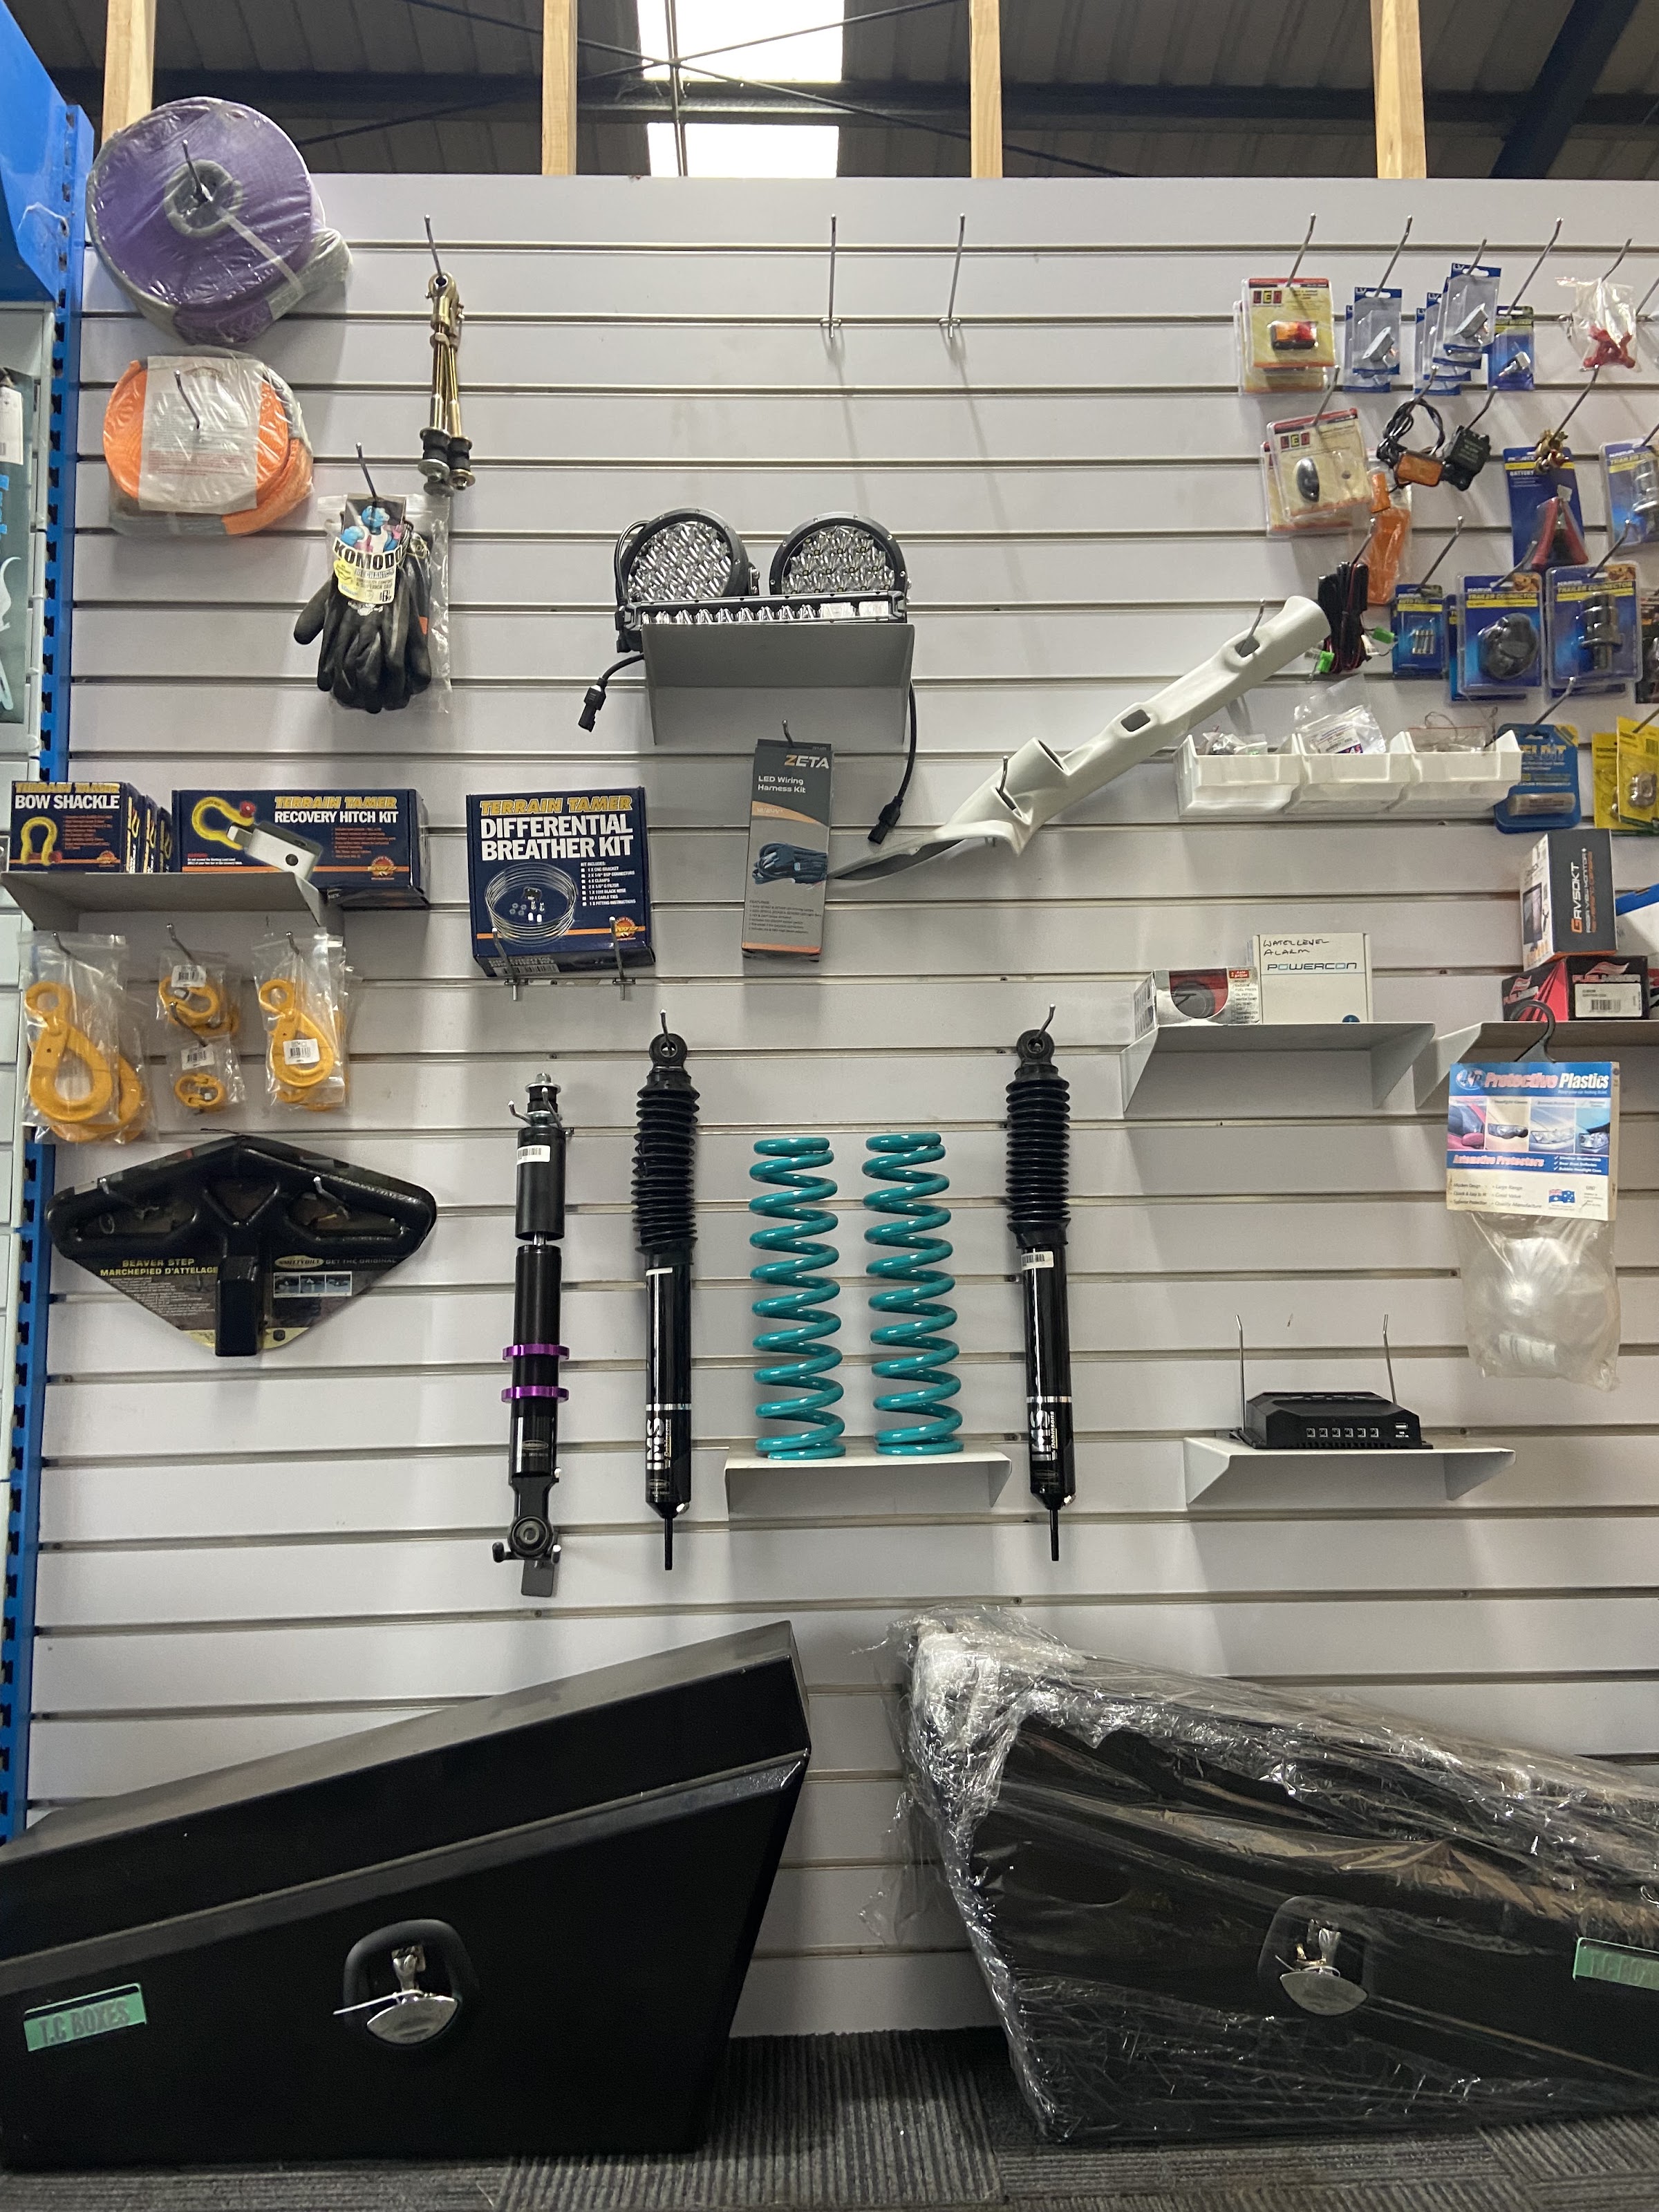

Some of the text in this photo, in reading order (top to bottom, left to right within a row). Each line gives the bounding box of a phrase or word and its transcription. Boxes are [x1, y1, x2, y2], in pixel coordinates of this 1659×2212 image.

[334, 540, 403, 570] KOMODO
[784, 754, 830, 769] ZETA
[778, 776, 804, 785] Wiring
[758, 785, 792, 793] Harness
[15, 795, 120, 809] BOW SHACKLE
[274, 796, 397, 809] TERRAIN TAMER
[480, 795, 632, 816] TERRAIN TAMER
[274, 810, 399, 823] RECOVERY HITCH KIT
[480, 813, 633, 838] DIFFERENTIAL
[482, 834, 634, 861] BREATHER KIT
[1267, 962, 1357, 971] POWERCON
[1485, 1072, 1609, 1089] Protective Plastics
[1453, 1154, 1544, 1167] Automotive Protectors
[122, 1258, 195, 1268] BEAVER STEP
[100, 1266, 218, 1276] MARCHEPIED D'ATTELAGE
[1030, 1410, 1051, 1461] IMS
[646, 1417, 664, 1470] IMS
[39, 1999, 131, 2046] T.C BOXES
